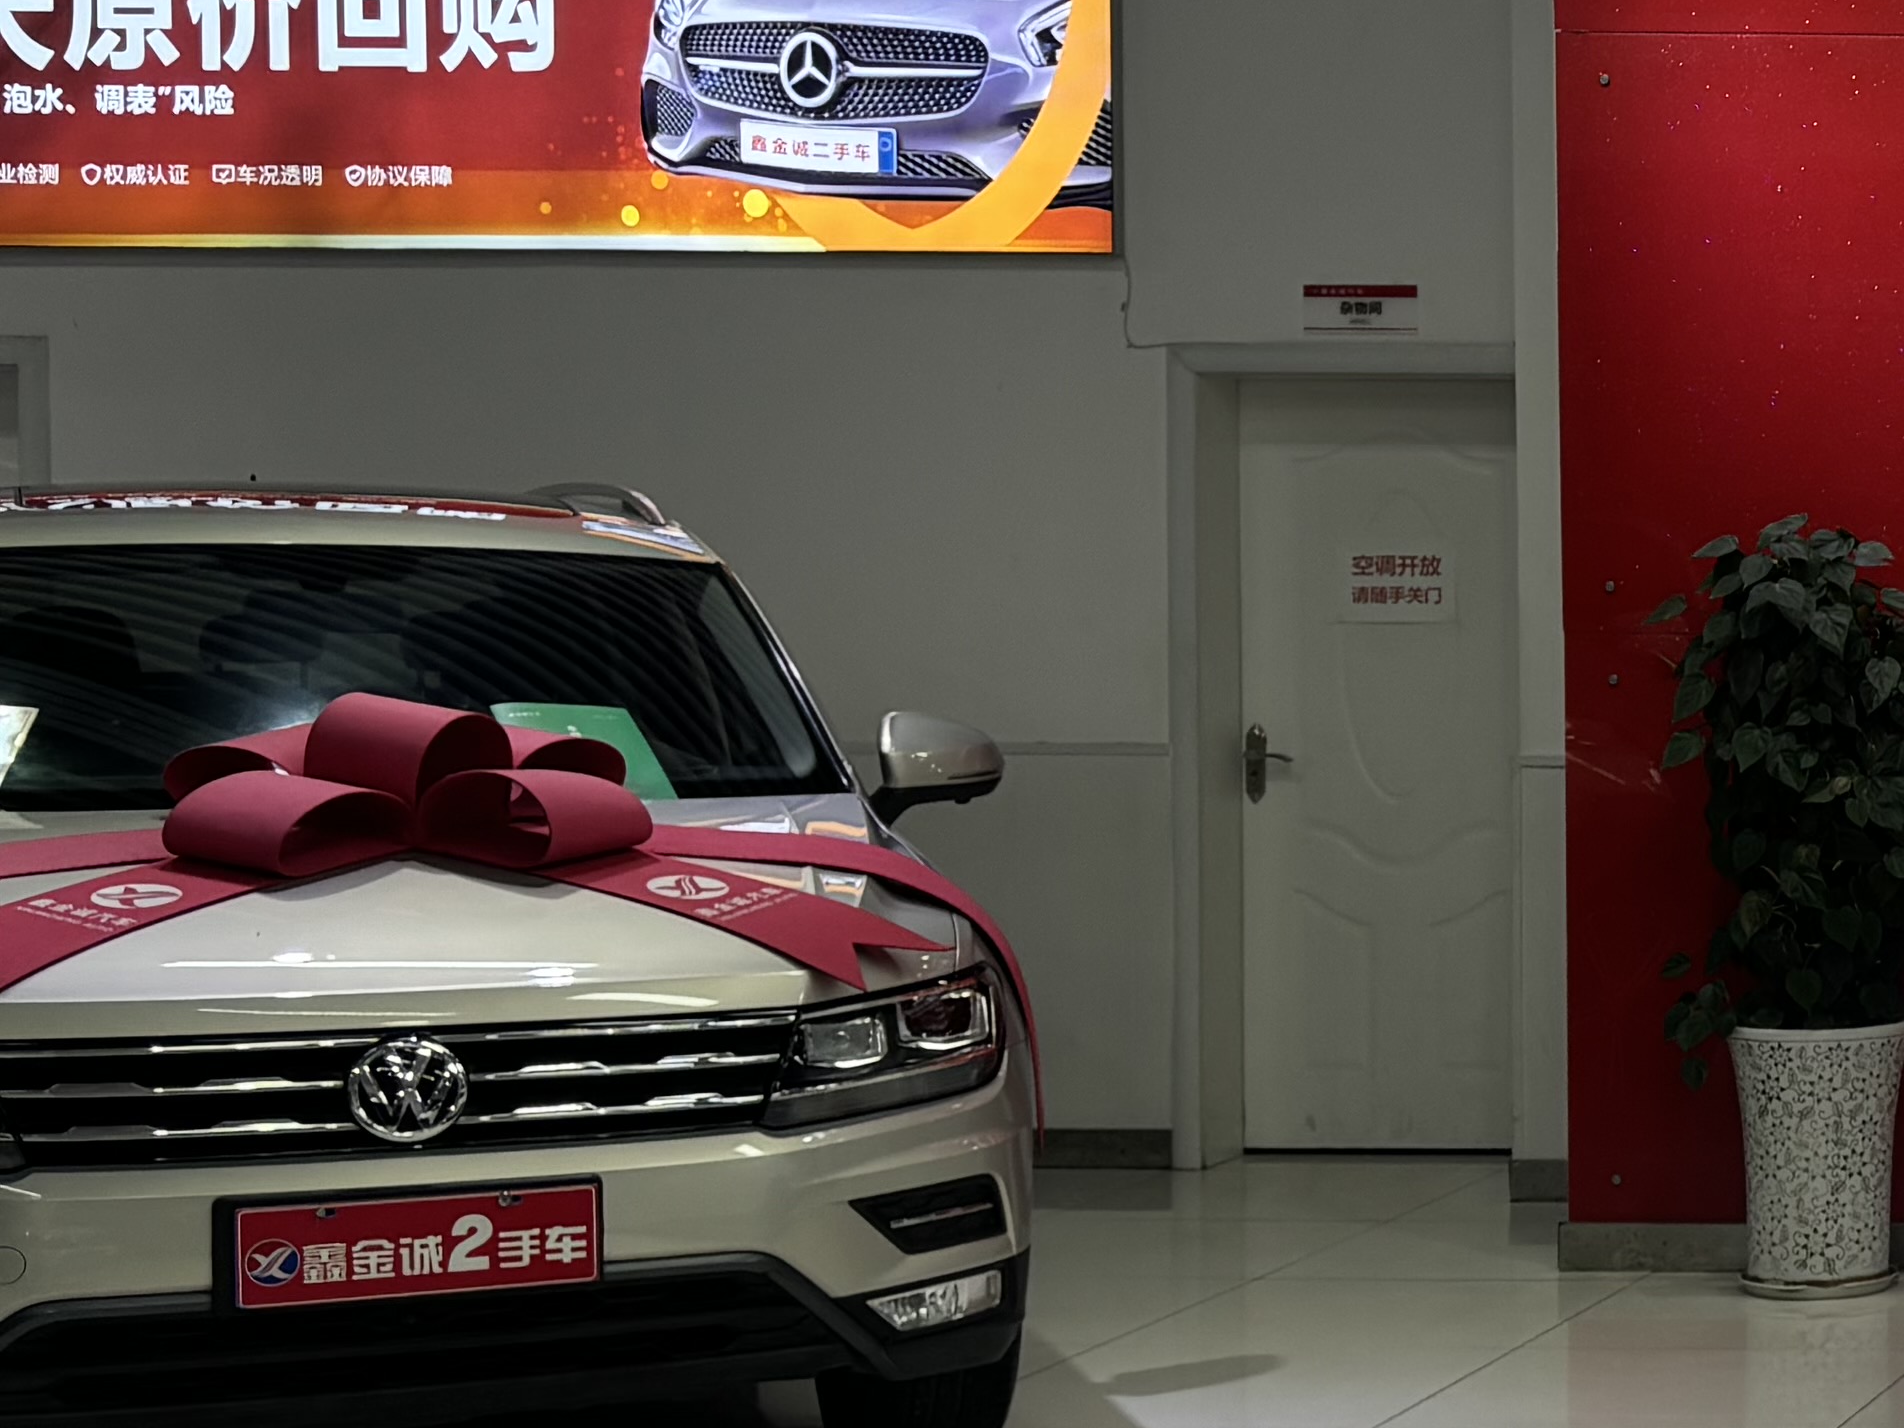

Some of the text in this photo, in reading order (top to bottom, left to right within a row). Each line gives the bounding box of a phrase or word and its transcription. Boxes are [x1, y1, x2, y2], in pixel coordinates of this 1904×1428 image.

[103, 163, 190, 186] 权威认证
[235, 164, 323, 186] 车况透明
[366, 164, 453, 187] 协议保障
[1352, 554, 1443, 578] 空调开放
[1352, 586, 1443, 605] 请随手关门
[302, 1213, 588, 1285] 鑫金诚2手车
